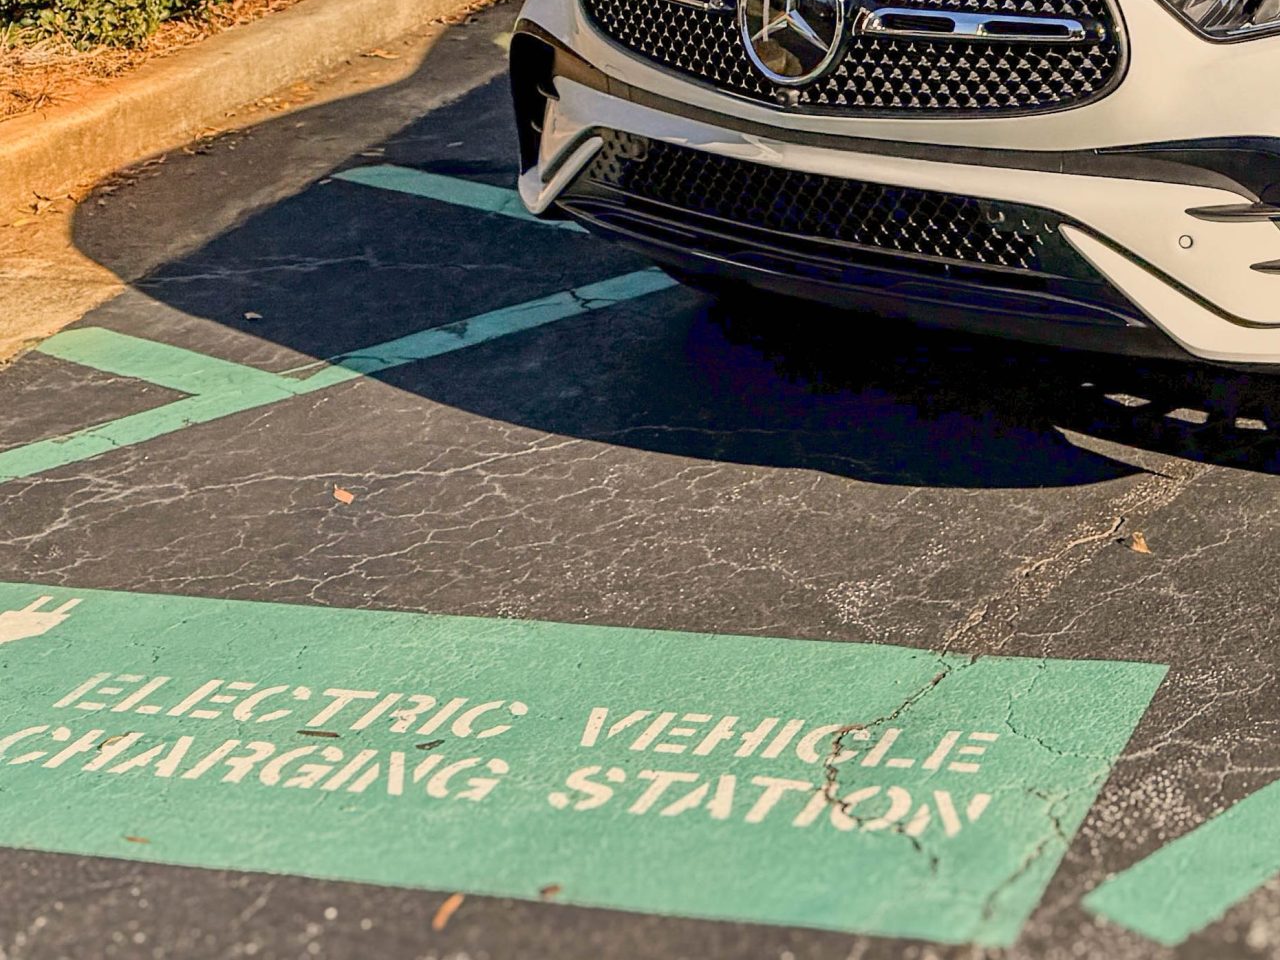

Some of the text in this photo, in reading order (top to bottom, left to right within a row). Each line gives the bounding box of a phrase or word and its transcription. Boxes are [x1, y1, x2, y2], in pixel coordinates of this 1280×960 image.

[52, 672, 1000, 773] ELECTRIC VEHICLE
[0, 724, 992, 838] CHARGING STATION
